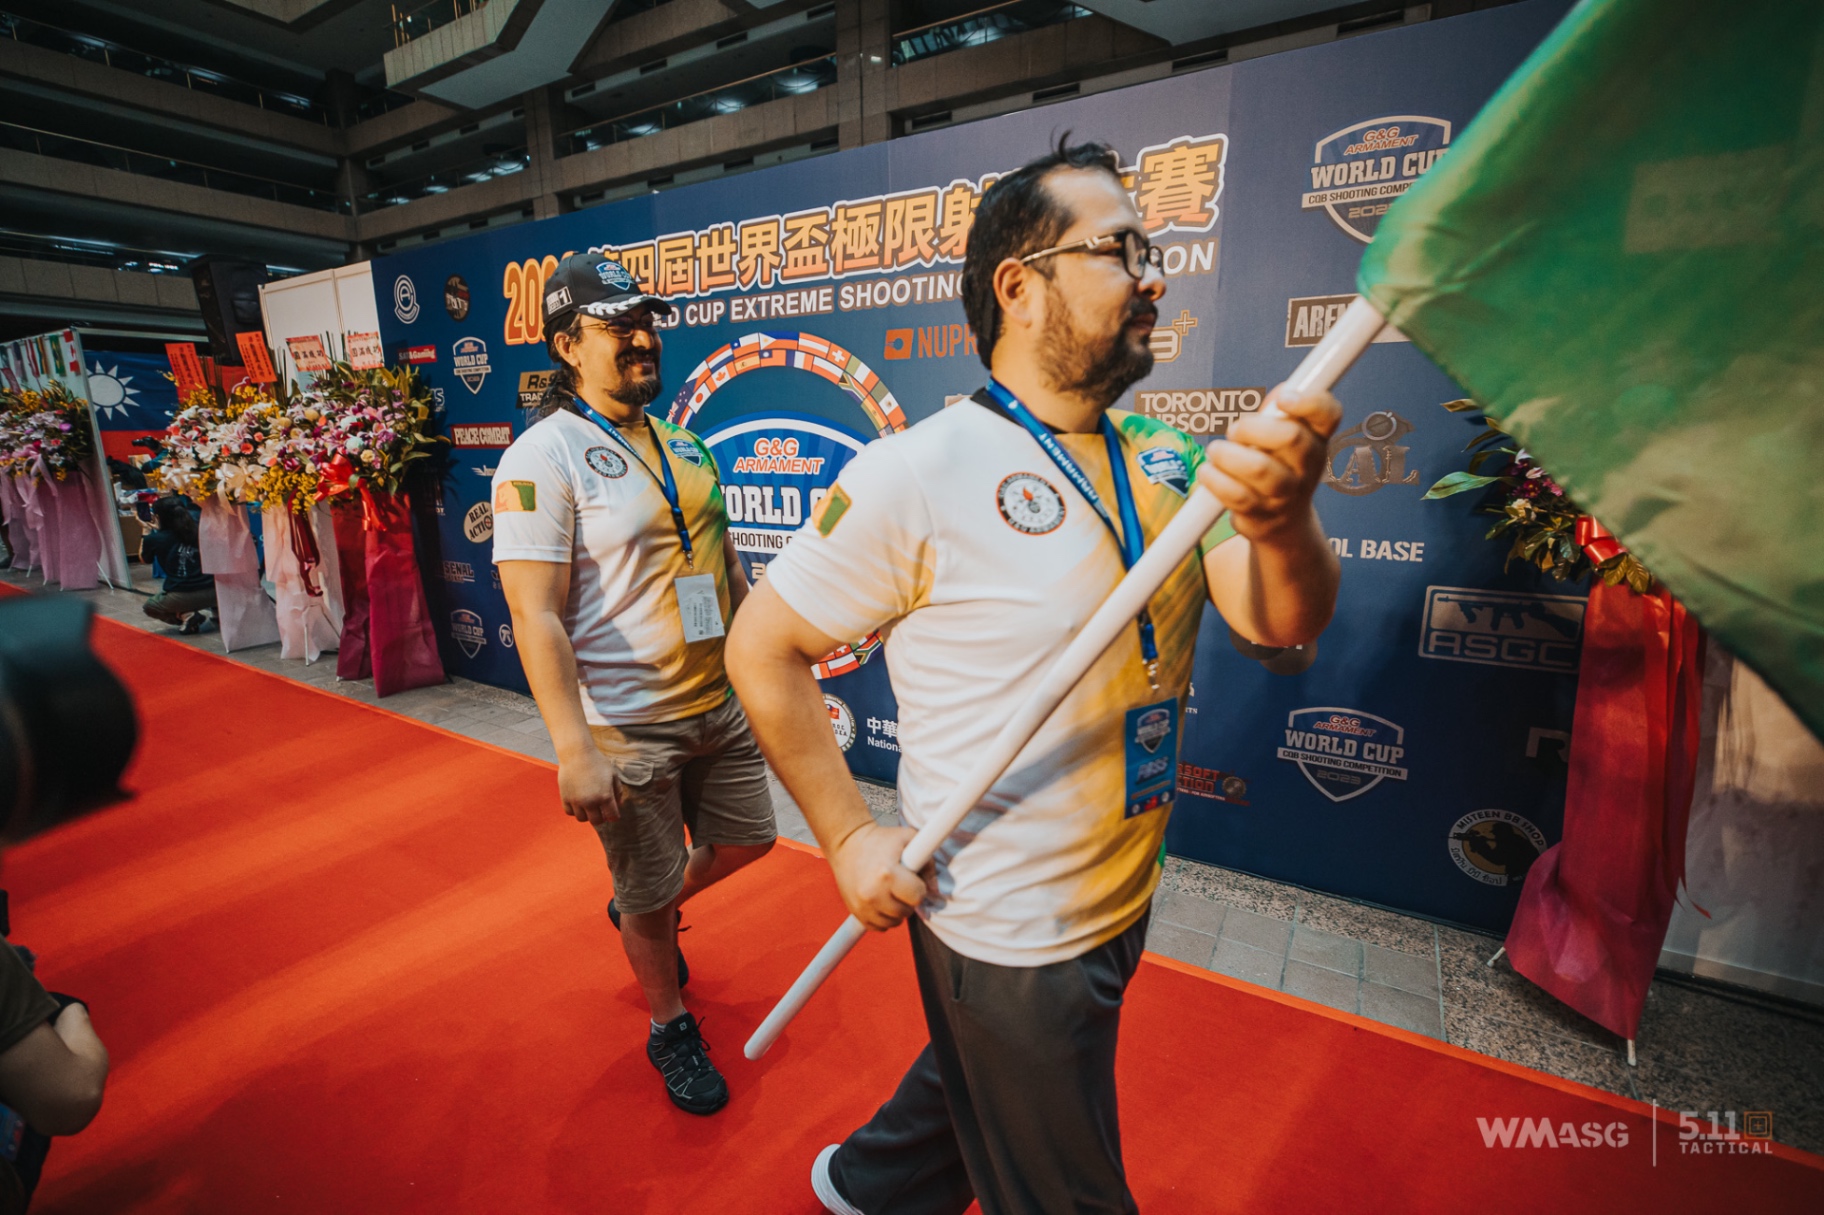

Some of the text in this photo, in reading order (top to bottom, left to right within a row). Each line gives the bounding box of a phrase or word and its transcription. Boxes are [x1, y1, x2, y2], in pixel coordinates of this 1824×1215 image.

[1344, 134, 1419, 156] ARMAMENT
[1363, 126, 1400, 142] G&G
[1311, 148, 1449, 189] WORLD CU
[1308, 193, 1327, 204] CQB
[1330, 187, 1377, 201] SHOOTING
[1349, 204, 1392, 218] 202
[504, 251, 577, 345] 20
[686, 302, 725, 325] CUP
[731, 288, 833, 321] EXTREME
[1292, 303, 1351, 338] ARE
[918, 324, 978, 358] NUPR
[1141, 389, 1261, 413] TORONTO
[453, 426, 511, 445] PEACE COMBAT
[754, 437, 799, 457] G&G
[733, 457, 825, 475] ARMAMENT
[469, 502, 489, 523] REAL
[720, 485, 801, 526] ORLD
[469, 515, 493, 541] ACTIO
[1360, 539, 1425, 562] BASE
[444, 562, 475, 577] SENAL
[1428, 631, 1576, 666] ASGC
[867, 716, 897, 738] 中華
[1313, 721, 1376, 737] ARMAMENT
[1329, 715, 1360, 727] G&G
[867, 736, 902, 753] Nationa
[1285, 729, 1404, 764] WORLD CUP
[1177, 763, 1220, 780] RSOFT
[1282, 749, 1402, 777] CQB SHOOTING COMPETITION
[1456, 811, 1544, 846] MISTEEN BB SHOP
